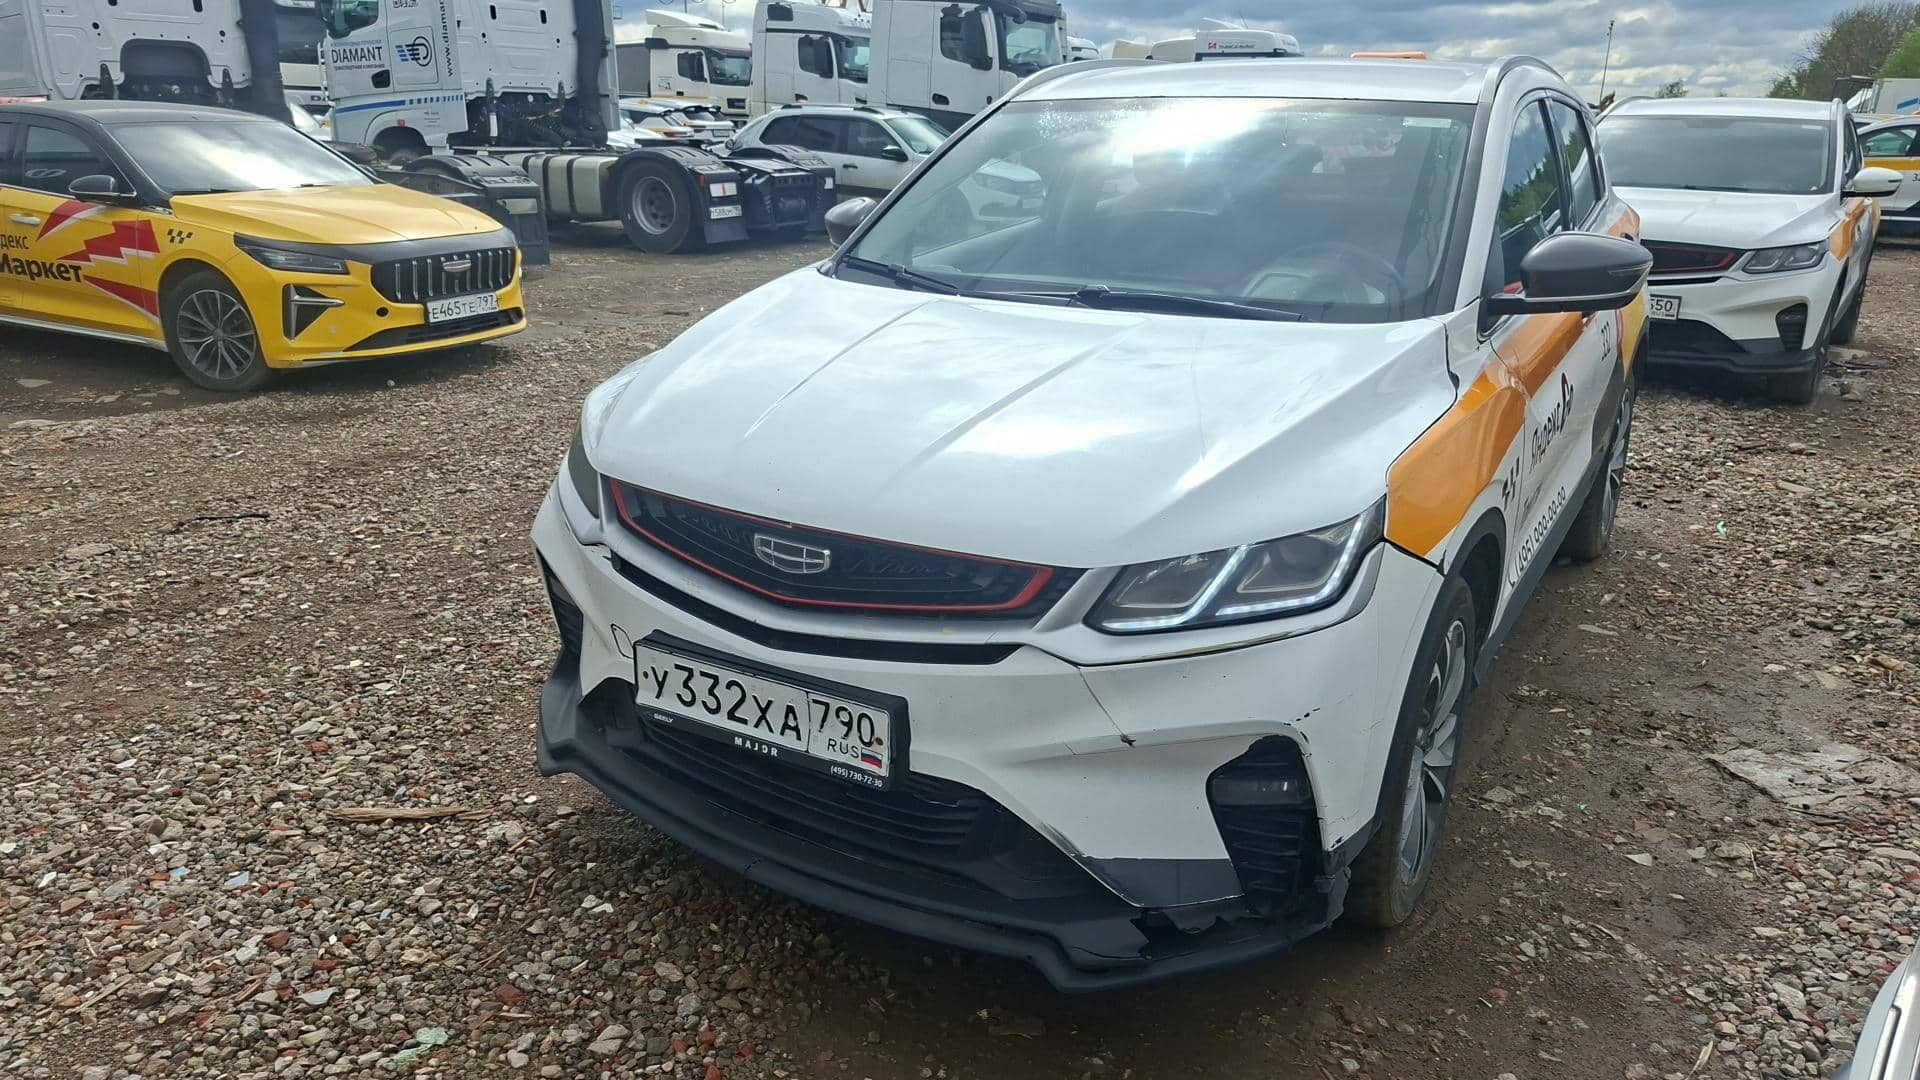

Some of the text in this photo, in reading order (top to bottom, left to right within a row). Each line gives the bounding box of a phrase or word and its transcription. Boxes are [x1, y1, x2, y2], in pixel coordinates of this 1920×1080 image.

[331, 46, 382, 63] DIAMANT
[432, 294, 494, 320] Е465ТЕ 797
[651, 663, 875, 748] У332ХА 790
[734, 736, 778, 757] MAJOR
[827, 738, 860, 760] RUS
[830, 764, 883, 788] (495) 730-72-30
